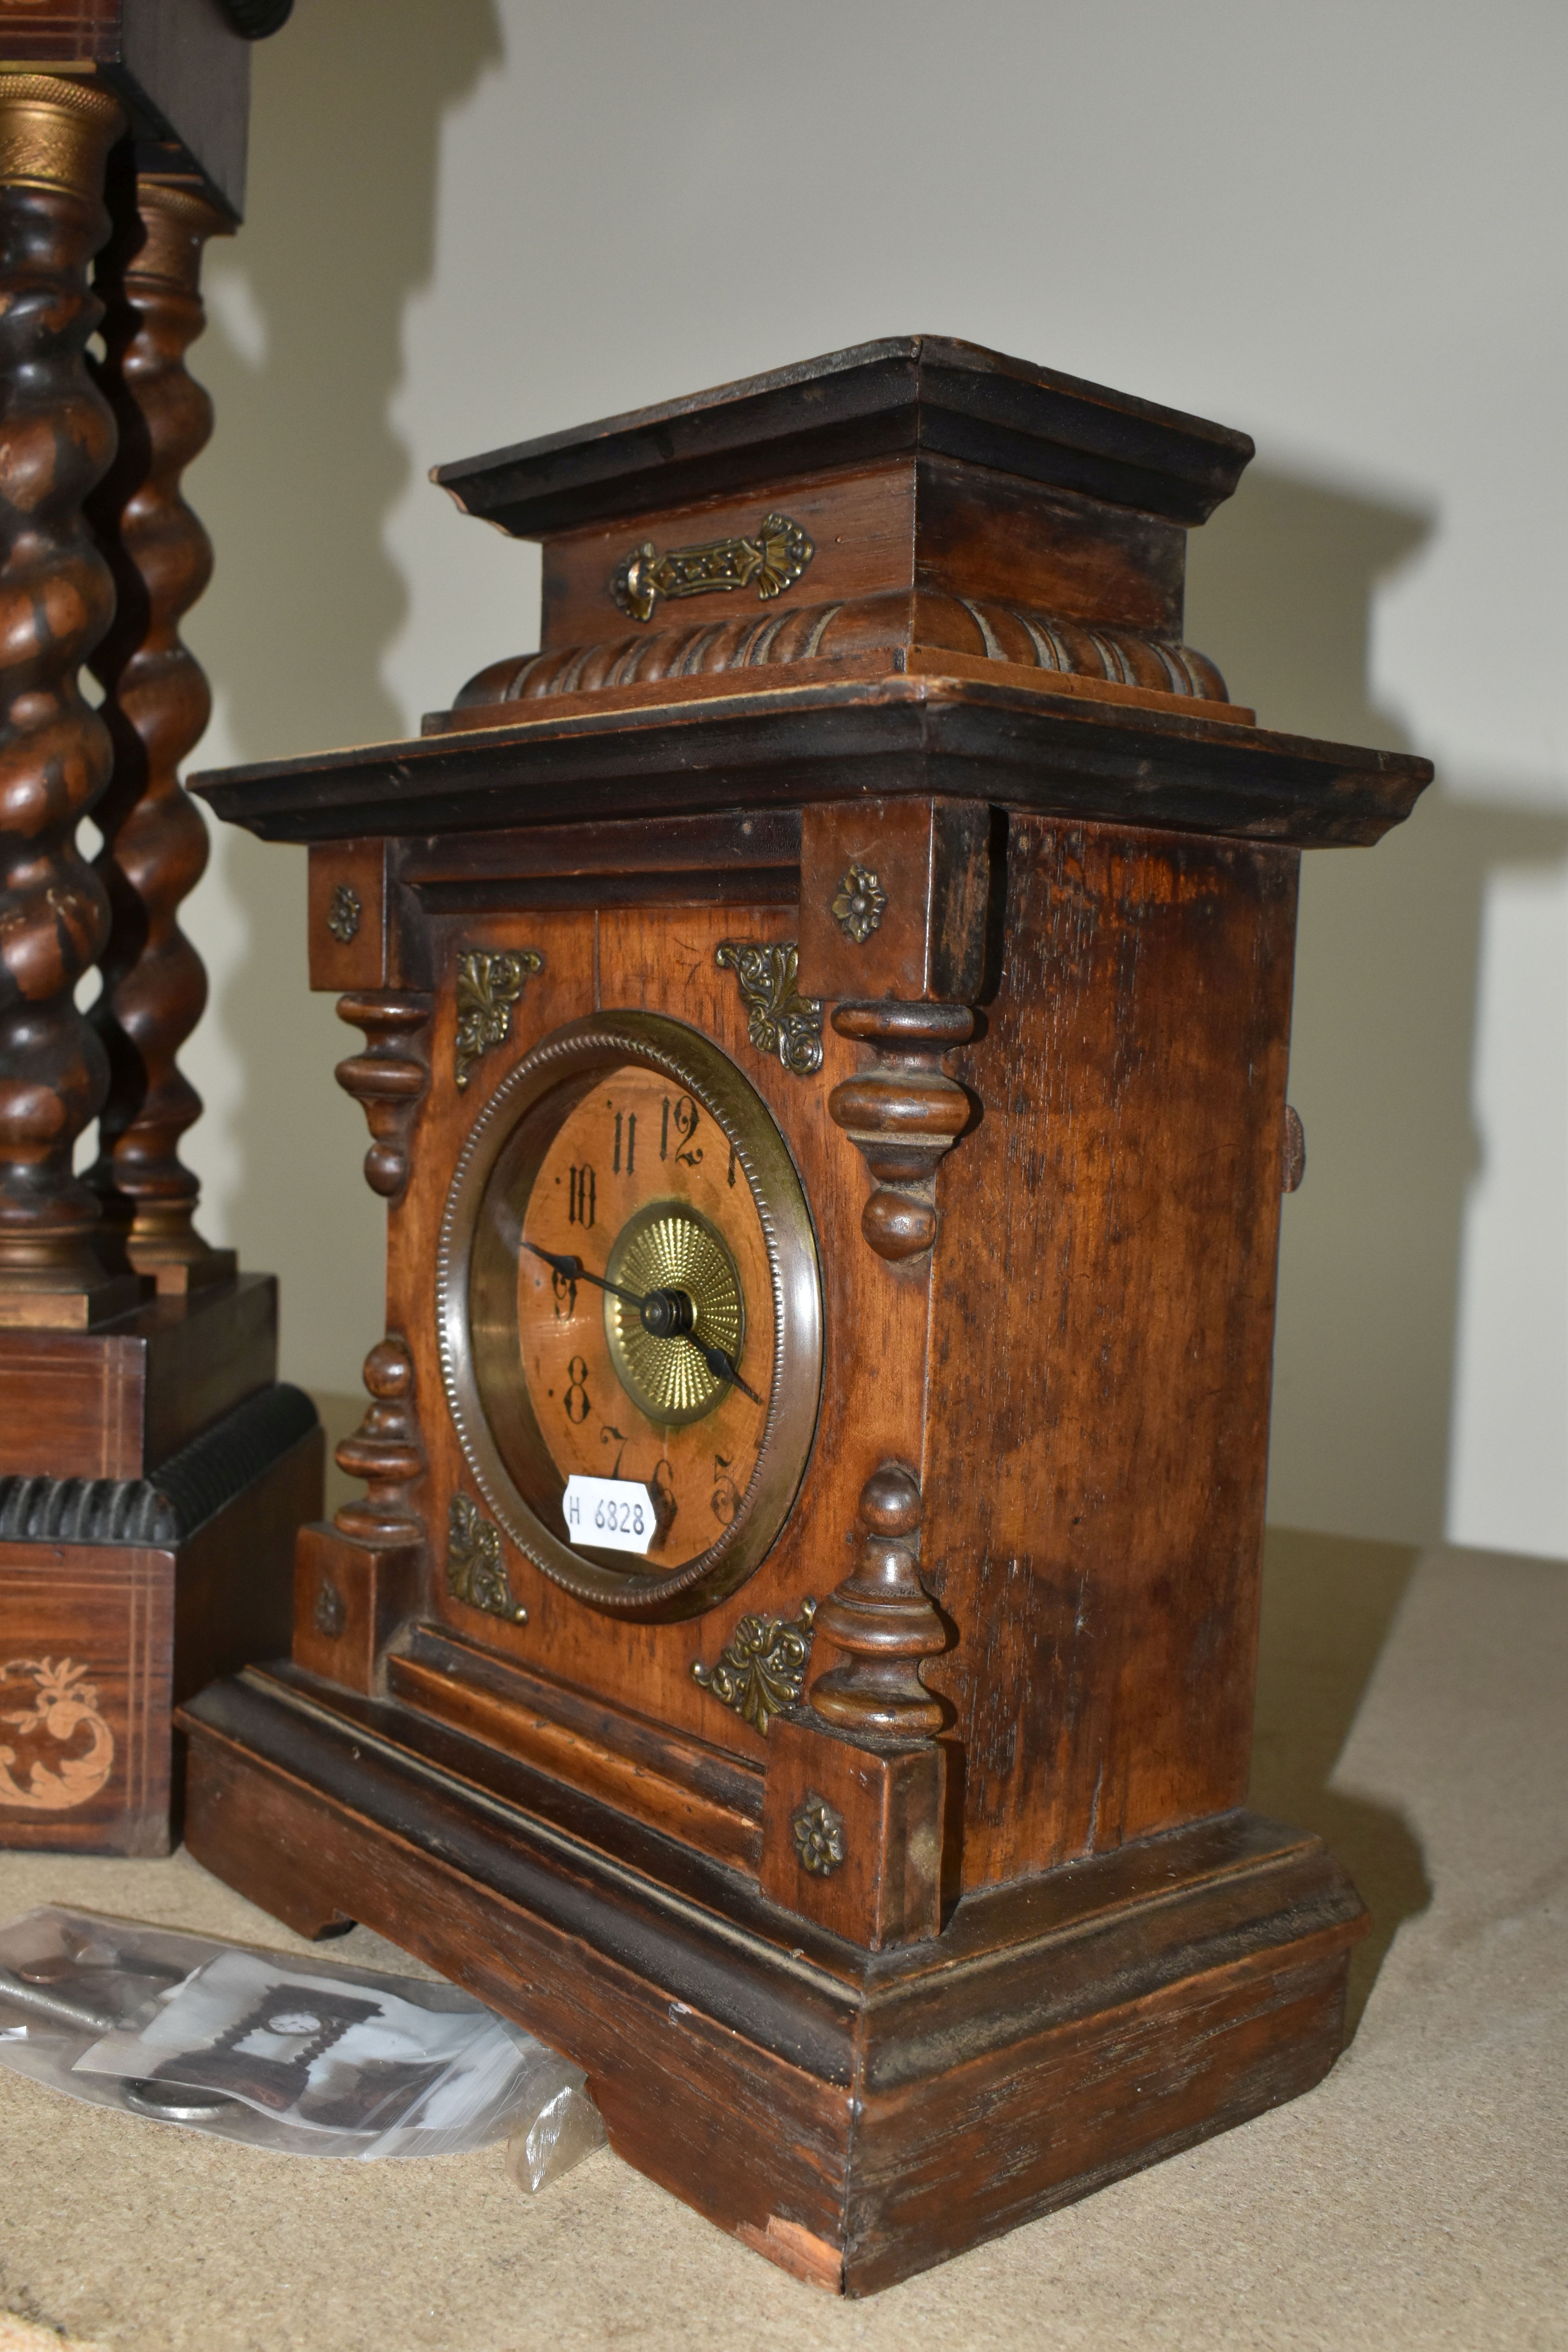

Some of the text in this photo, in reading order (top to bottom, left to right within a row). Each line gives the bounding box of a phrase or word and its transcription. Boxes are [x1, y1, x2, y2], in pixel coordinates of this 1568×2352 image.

[612, 1111, 637, 1176] 11
[660, 1095, 703, 1167] 12
[569, 1164, 596, 1230] 10
[551, 1267, 577, 1322] 9
[563, 1355, 591, 1424] 8
[600, 1425, 627, 1480] 7
[569, 1495, 644, 1535] H 6828
[711, 1454, 743, 1526] 5
